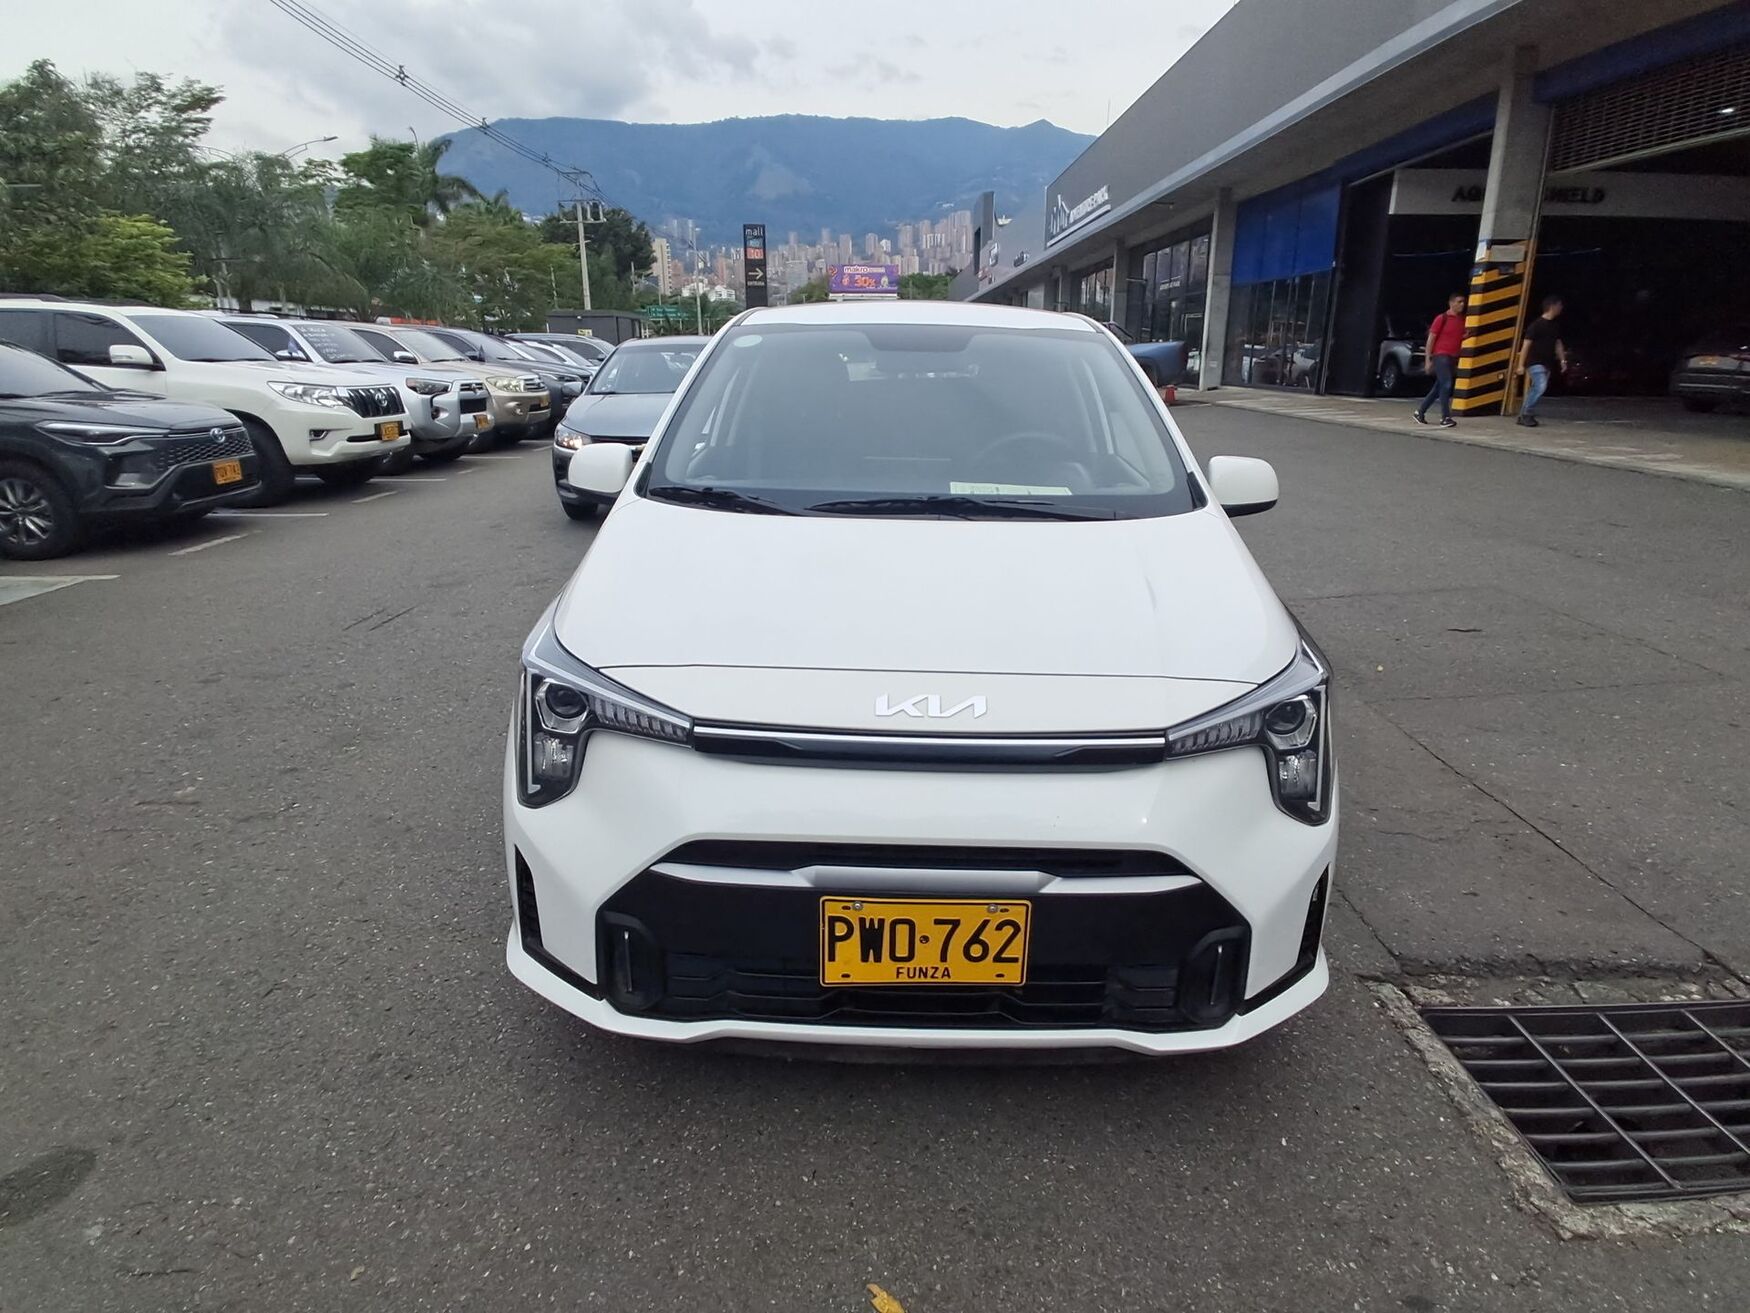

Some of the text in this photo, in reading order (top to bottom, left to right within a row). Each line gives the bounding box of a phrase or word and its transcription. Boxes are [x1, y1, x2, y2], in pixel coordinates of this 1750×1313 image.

[745, 227, 763, 236] mall
[875, 692, 988, 719] KIA
[895, 965, 952, 980] FUNZA
